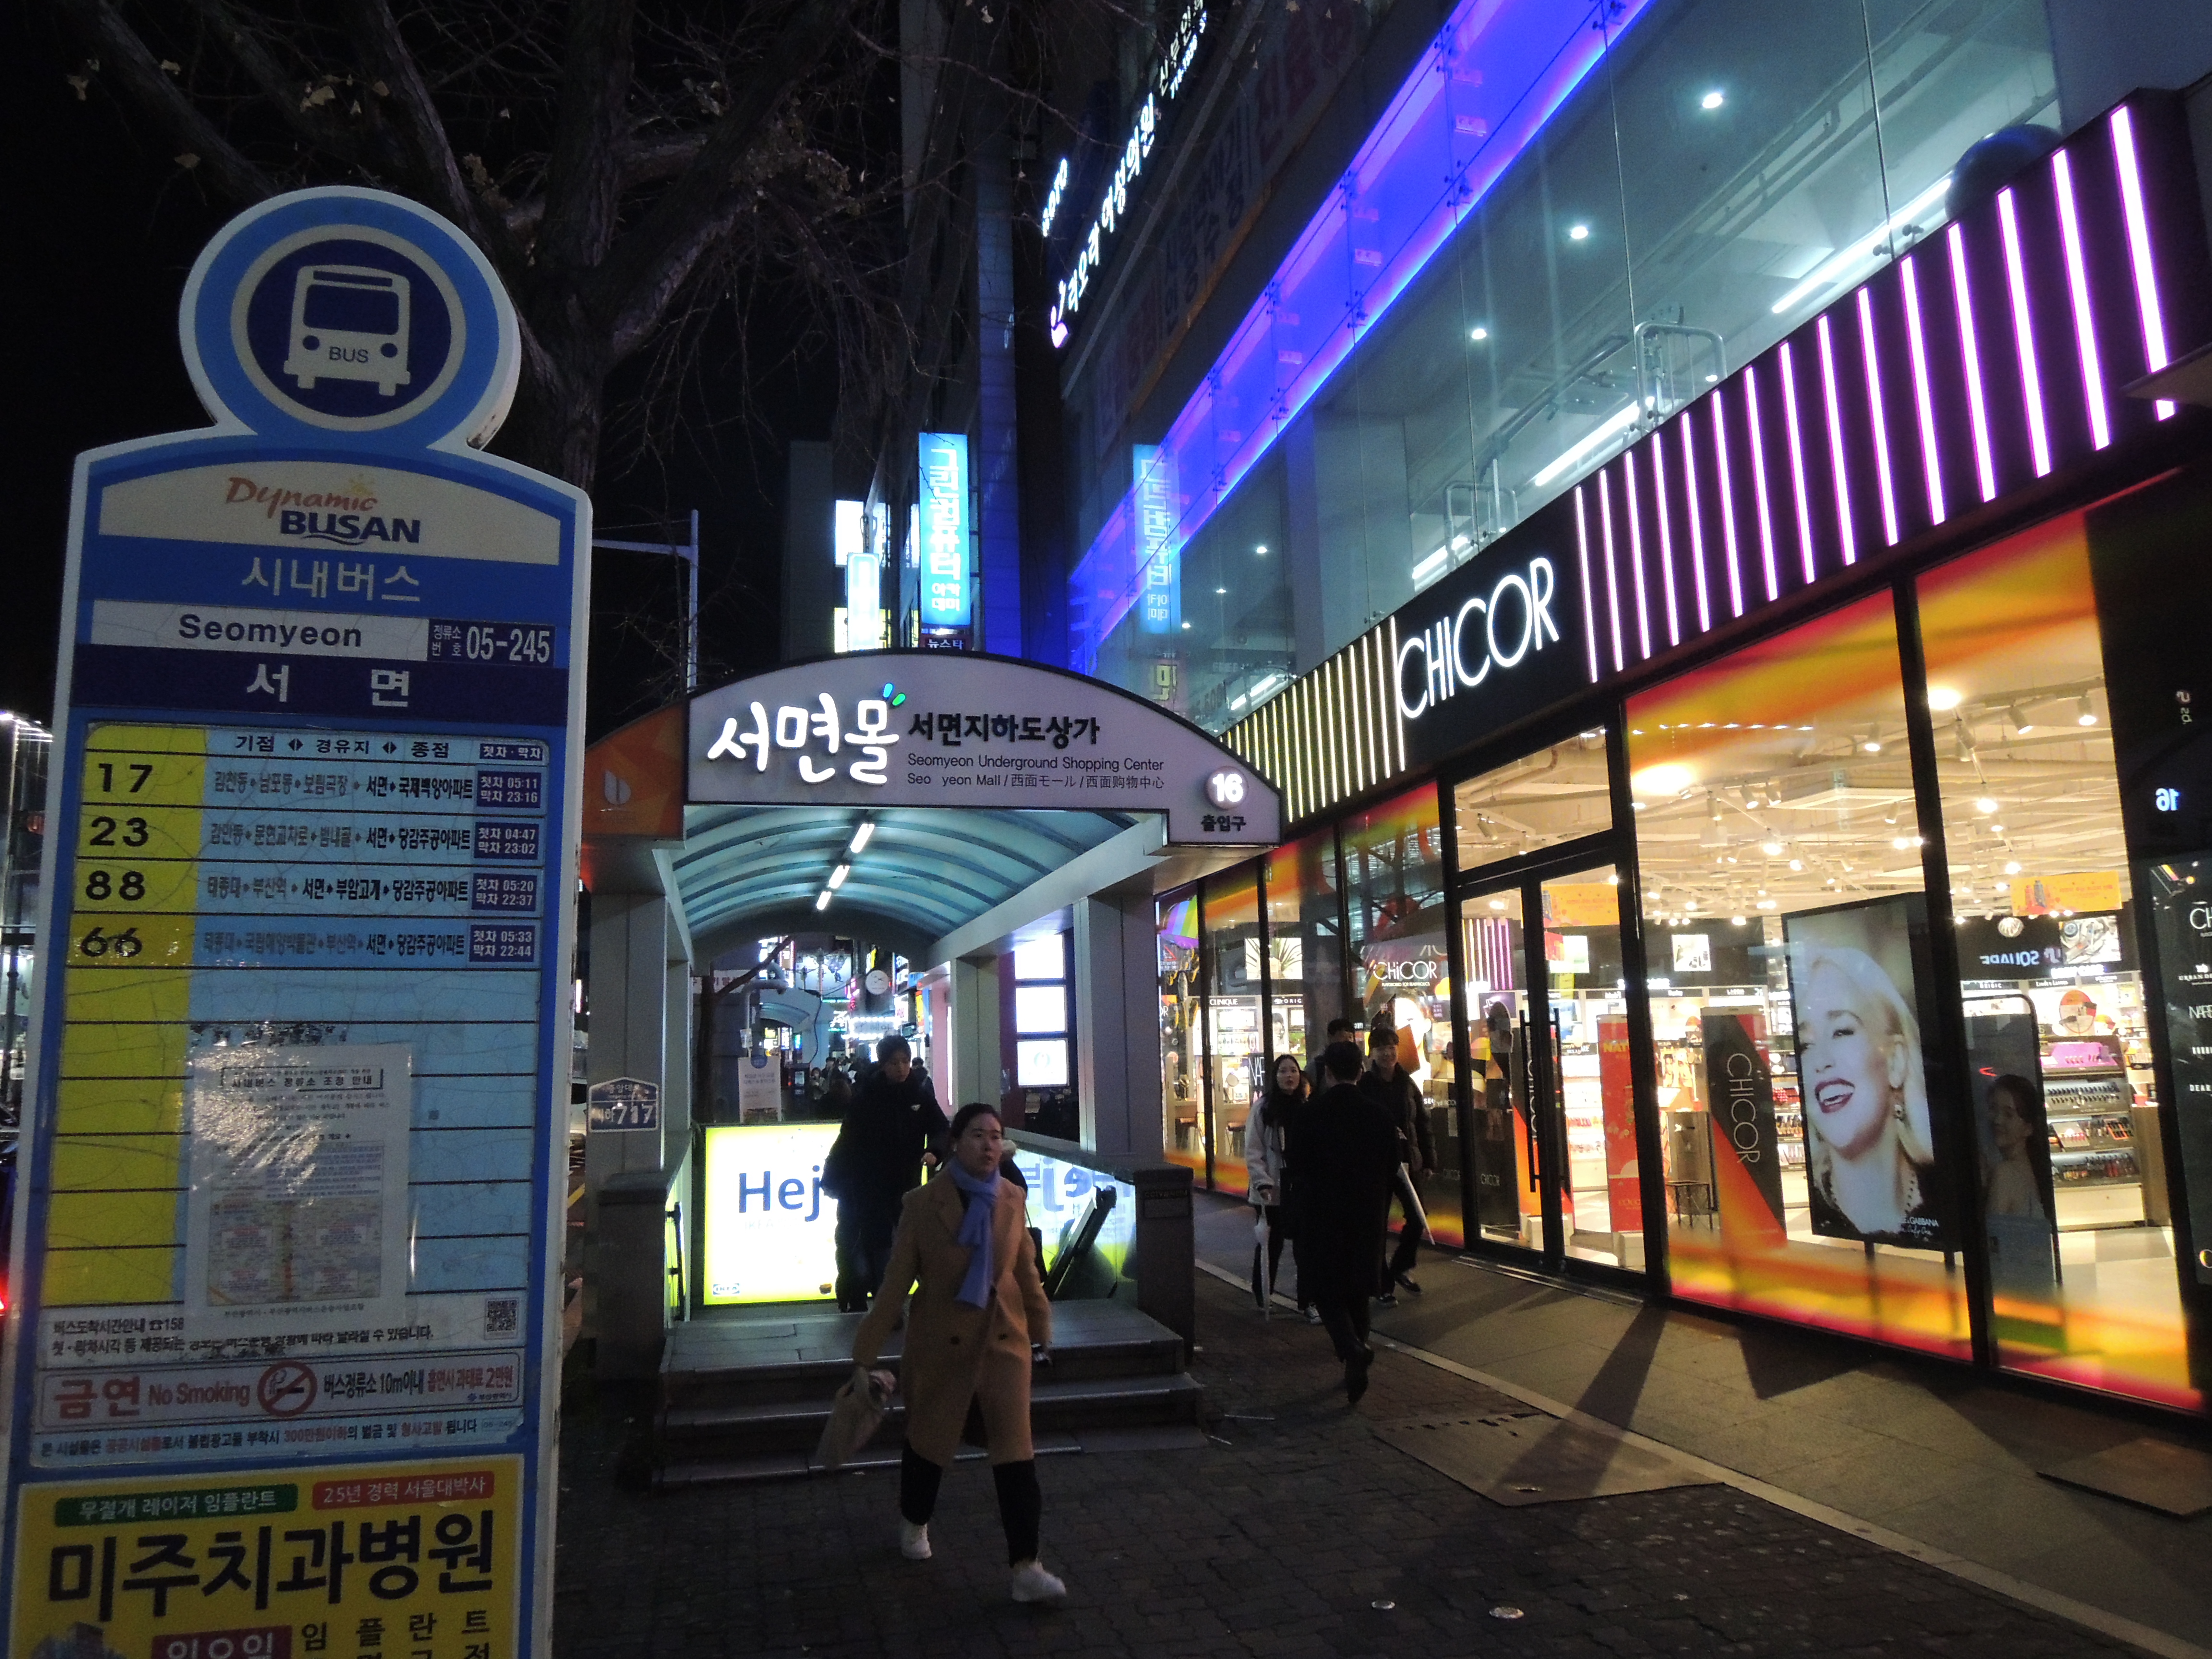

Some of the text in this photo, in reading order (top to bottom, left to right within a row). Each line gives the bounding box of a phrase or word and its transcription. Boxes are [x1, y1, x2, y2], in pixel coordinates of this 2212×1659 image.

[329, 347, 369, 363] BUS
[226, 476, 379, 518] Dynamic
[280, 510, 421, 543] BUSAN
[241, 556, 421, 602] 시내버스
[179, 613, 362, 649] Seomyeon
[433, 624, 461, 640] 정류소
[927, 639, 963, 649] 뉴스타
[1396, 557, 1560, 718] CHICOR
[467, 629, 550, 663] 05-245
[708, 692, 900, 784] 서면몰
[908, 712, 1100, 749] 서면지하도상가
[235, 735, 449, 758] 기점 경유지 종점
[908, 753, 1164, 772] Seomyeon Underground Shopping Center
[98, 763, 153, 793] 17
[367, 776, 387, 797] 서면
[399, 777, 473, 800] 국제백양아파트
[481, 776, 538, 789] 첫차 05:11
[976, 774, 1001, 786] Mall
[1011, 774, 1076, 788] 西面モール
[1087, 775, 1165, 790] 西面购物中心
[1213, 773, 1244, 803] 16
[507, 791, 538, 804] 23:16
[89, 816, 150, 847] 23
[478, 827, 536, 841] 첫차 04:47
[1202, 815, 1247, 831] 출입구
[367, 827, 387, 849] 서면
[398, 828, 470, 851] 당감주공아파트
[505, 842, 536, 854] 23:02
[85, 870, 146, 901] 88
[302, 878, 325, 900] 서면
[336, 878, 381, 901] 부암고개
[393, 879, 468, 902] 당감주공아파트
[476, 878, 534, 892] 첫차 05:20
[502, 894, 533, 906] 22:37
[80, 926, 143, 958] 66
[366, 933, 386, 955] 서면
[397, 934, 464, 956] 당감주공아파트
[473, 930, 532, 944] 첫차 05:33
[500, 946, 531, 958] 22:44
[1727, 1053, 1761, 1164] CHICOR
[739, 1165, 820, 1223] Hej
[54, 1318, 145, 1334] 버스도착시간안내
[124, 1337, 137, 1353] 등
[311, 1331, 334, 1345] 따라
[373, 1329, 384, 1342] 수
[387, 1325, 433, 1342] 있습니다.
[149, 1381, 251, 1408] No Smoking
[324, 1370, 377, 1399] 버스정류소
[379, 1369, 424, 1396] 10m이내
[486, 1365, 513, 1388] 2만원
[53, 1376, 141, 1419] 금연
[247, 1429, 280, 1447] 부착시
[362, 1423, 384, 1440] 벌금
[386, 1423, 398, 1439] 및
[446, 1419, 478, 1436] 됩니다
[324, 1477, 486, 1504] 25년 경력 서울대박사
[79, 1490, 277, 1521] 무절개 레이저 임플란트
[49, 1510, 493, 1622] 미주치과병원
